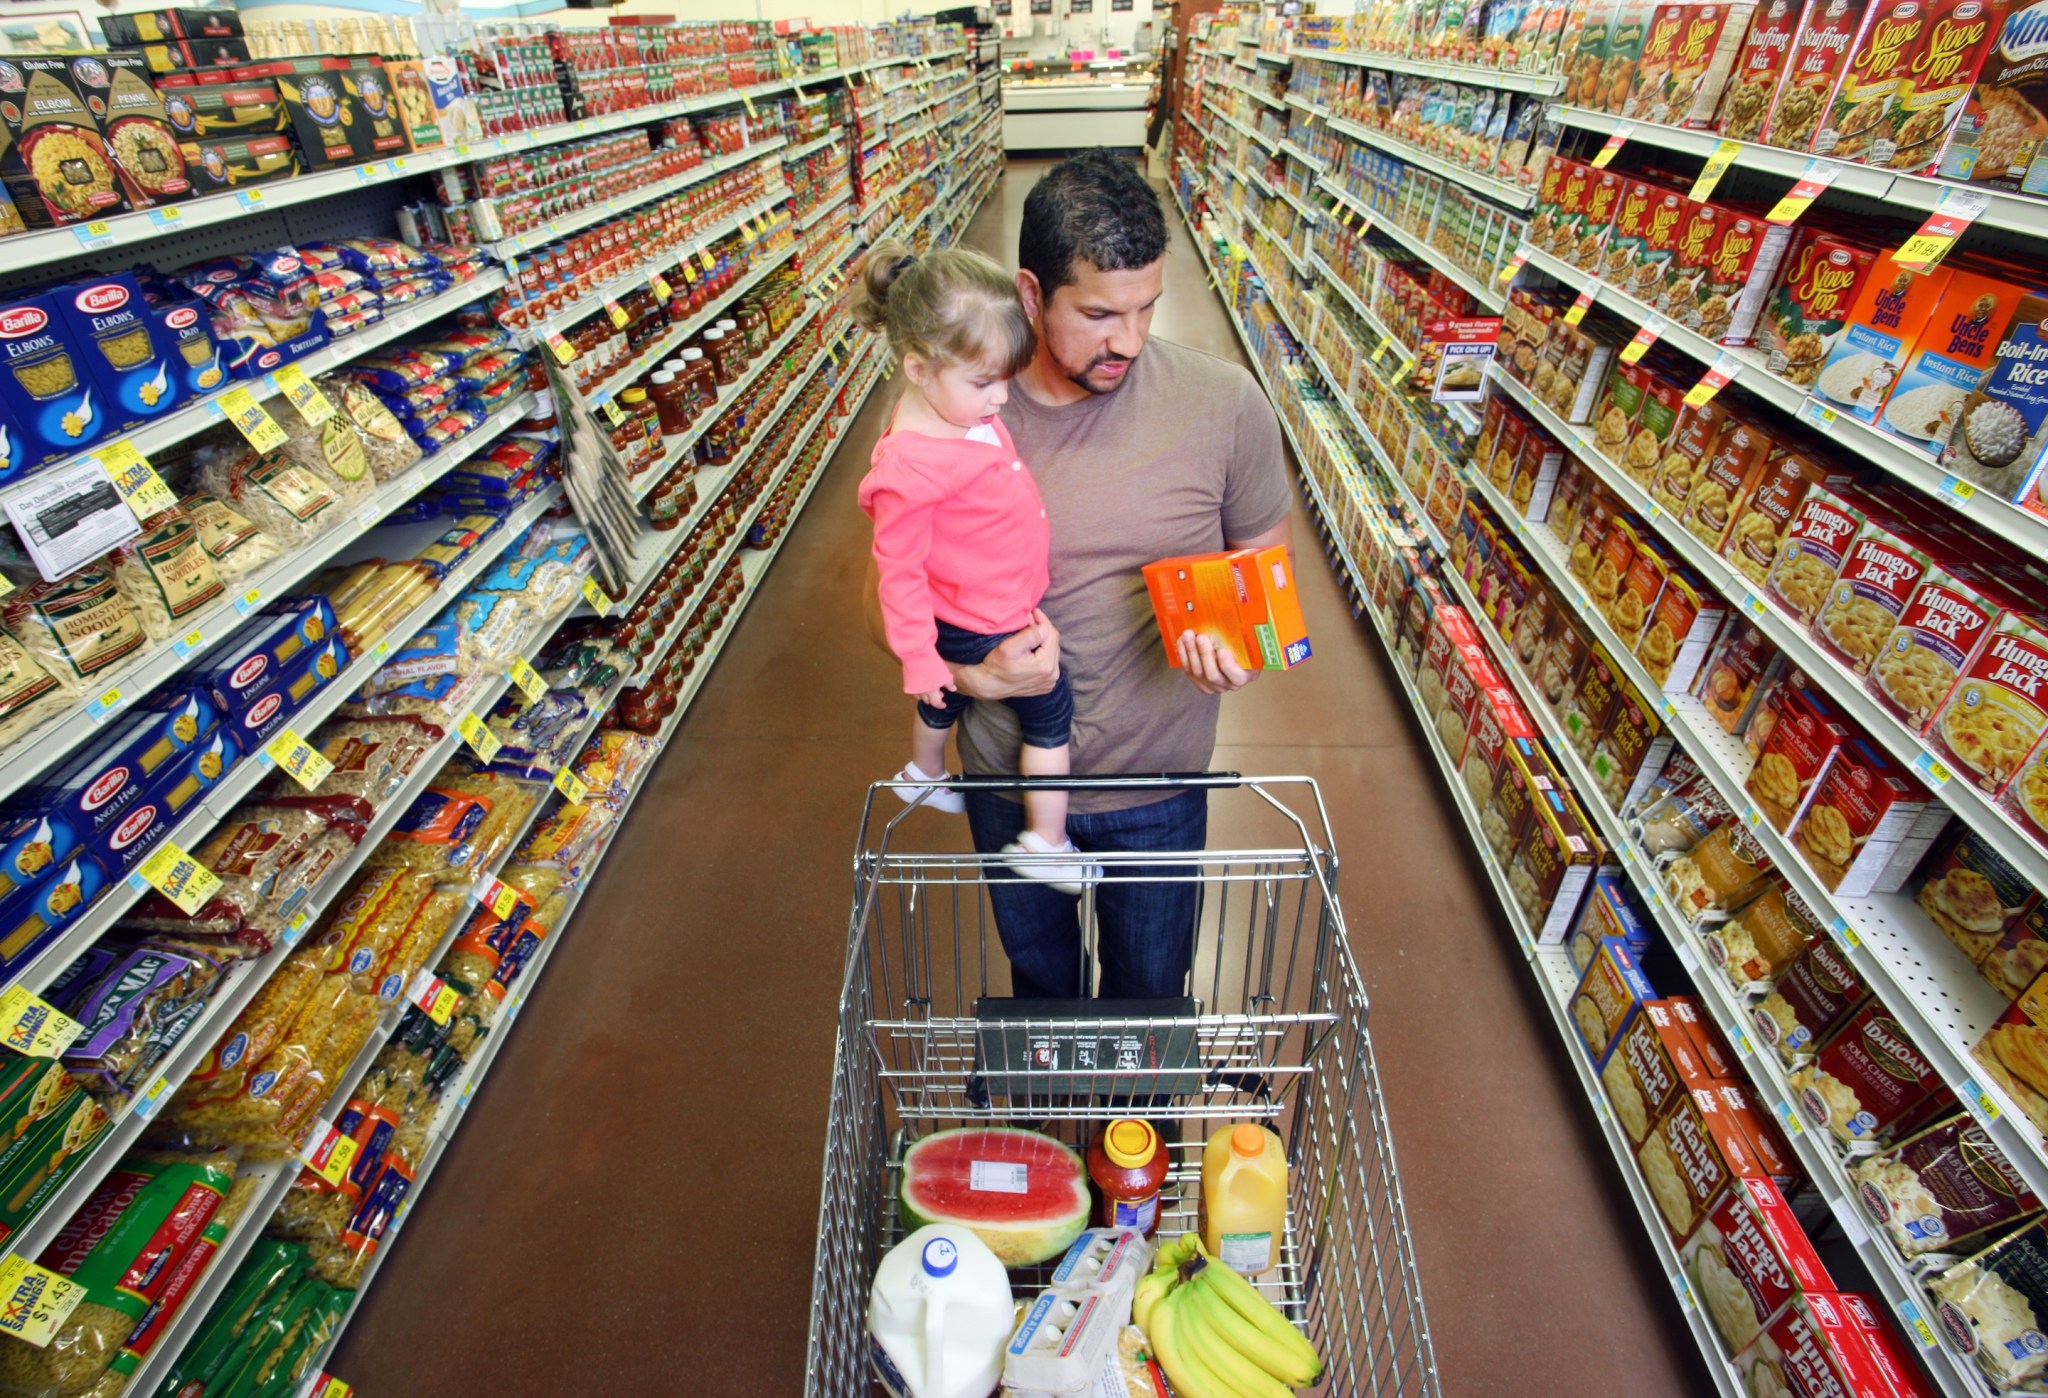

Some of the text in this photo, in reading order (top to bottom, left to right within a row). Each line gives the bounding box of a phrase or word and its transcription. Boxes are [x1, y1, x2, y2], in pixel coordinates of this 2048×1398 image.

[1678, 18, 1717, 58] Stove
[1684, 43, 1706, 65] Top
[1748, 26, 1791, 53] Stuffing
[1800, 26, 1850, 52] Stuffing
[1855, 18, 1922, 68] Stove
[1912, 18, 1986, 73] Stove
[23, 61, 48, 70] Gluten
[1748, 54, 1770, 70] Mix
[1800, 54, 1826, 73] Mix
[1864, 49, 1900, 81] Top
[1922, 52, 1962, 87] Top
[1997, 62, 2030, 82] Brown
[34, 98, 72, 110] ELBOW
[117, 93, 149, 104] PENNE
[1654, 227, 1670, 246] Top
[1679, 216, 1716, 250] Stove
[1686, 238, 1704, 259] Top
[1712, 229, 1752, 264] Stove
[1908, 239, 1938, 256] $1.99
[1720, 254, 1740, 275] Top
[1800, 260, 1854, 301] Stove
[90, 288, 124, 307] Barilla
[1808, 290, 1838, 316] Top
[1874, 288, 1906, 314] Uncle
[2, 312, 42, 332] Barilla
[92, 310, 134, 332] ELBOWS
[172, 312, 196, 325] Barilla
[1870, 311, 1902, 328] Ben's
[1950, 314, 1990, 343] Uncle
[6, 336, 54, 358] ELBOWS
[290, 334, 324, 354] TORTELLINI
[1450, 346, 1464, 354] PICK
[1464, 346, 1478, 354] ONE
[1851, 324, 1896, 353] Instant Rice
[1946, 337, 1984, 358] Ben's
[1922, 356, 1979, 384] Instant Rice
[2006, 362, 2048, 386] Rice
[236, 406, 258, 428] EXTRA
[257, 424, 281, 440] $1.49
[1678, 428, 1704, 457] Cheese
[115, 462, 145, 492] EXTRA
[122, 468, 154, 498] SAVINGS!
[1712, 454, 1740, 486] Cheese
[137, 482, 168, 504] $1.49
[1758, 484, 1790, 519] Cheese
[1802, 502, 1854, 538] Hungry
[1802, 523, 1838, 546] Jack
[1856, 541, 1920, 581] Hungry
[1856, 562, 1898, 592] Jack
[69, 606, 130, 640] NOODLES
[1918, 584, 1985, 631] Hungry
[1913, 630, 1936, 646] Creamy
[1916, 608, 1962, 642] Jack
[238, 658, 264, 684] Barilla
[417, 662, 447, 674] FLAVOR
[1452, 662, 1476, 698] Hungry
[1988, 660, 2043, 698] Jack
[1450, 681, 1467, 706] Jack
[1584, 682, 1603, 712] Buds
[1586, 666, 1611, 704] Potato
[1965, 689, 1980, 706] 15
[252, 696, 279, 724] Barilla
[1478, 704, 1503, 747] Hungry
[1476, 724, 1494, 754] Jack
[1613, 726, 1634, 757] Buds
[1617, 710, 1644, 748] Potato
[1779, 718, 1820, 765] Cheesy Scalloped
[303, 756, 326, 778] $1.49
[91, 770, 125, 803] Barilla
[1500, 786, 1517, 818] Buds
[1502, 770, 1525, 810] Potato
[1830, 768, 1874, 820] Cheesy Scalloped
[93, 784, 138, 827] ANGEL HAIR
[119, 810, 152, 842] Barilla
[1731, 822, 1769, 860] IDAHOAN
[121, 821, 166, 865] ANGEL HAIR
[1532, 827, 1556, 872] Potato
[1530, 844, 1549, 878] Buds
[1969, 832, 2034, 892] Loaded Casserole
[162, 860, 190, 896] EXTRA
[169, 862, 197, 900] SAVINGS!
[184, 871, 214, 900] $1.49
[117, 954, 162, 998] MAC
[1812, 944, 1854, 990] IDAHOAN
[1812, 984, 1838, 1013] BAKED
[6, 1004, 40, 1047] EXTRA
[19, 1005, 51, 1051] SAVINGS!
[36, 1016, 70, 1049] $1.49
[1634, 1020, 1669, 1091] Idaho
[1862, 1021, 1932, 1079] IDAHOAN
[1626, 1034, 1662, 1106] Spuds
[1846, 1040, 1904, 1096] FOUR CHEESE
[330, 1144, 352, 1172] $1.59
[1666, 1118, 1711, 1200] Spuds
[1676, 1105, 1718, 1182] Idaho
[26, 1168, 63, 1210] LINGUINE
[1861, 1182, 1890, 1224] IDAHOAN
[1961, 1174, 1990, 1202] REDS
[59, 1176, 151, 1276] macaroni
[176, 1193, 218, 1245] macaroni
[1725, 1230, 1770, 1286] Jack
[1728, 1200, 1790, 1290] Hungry
[166, 1242, 209, 1297] macaroni
[0, 1275, 38, 1328] EXTRA
[12, 1272, 50, 1332] SAVINGS!
[32, 1280, 72, 1323] $1.43
[1034, 1299, 1050, 1324] Grade
[1016, 1331, 1032, 1350] Large
[1917, 1320, 1932, 1343] 1.19
[1941, 1308, 1974, 1352] IDAHOAN
